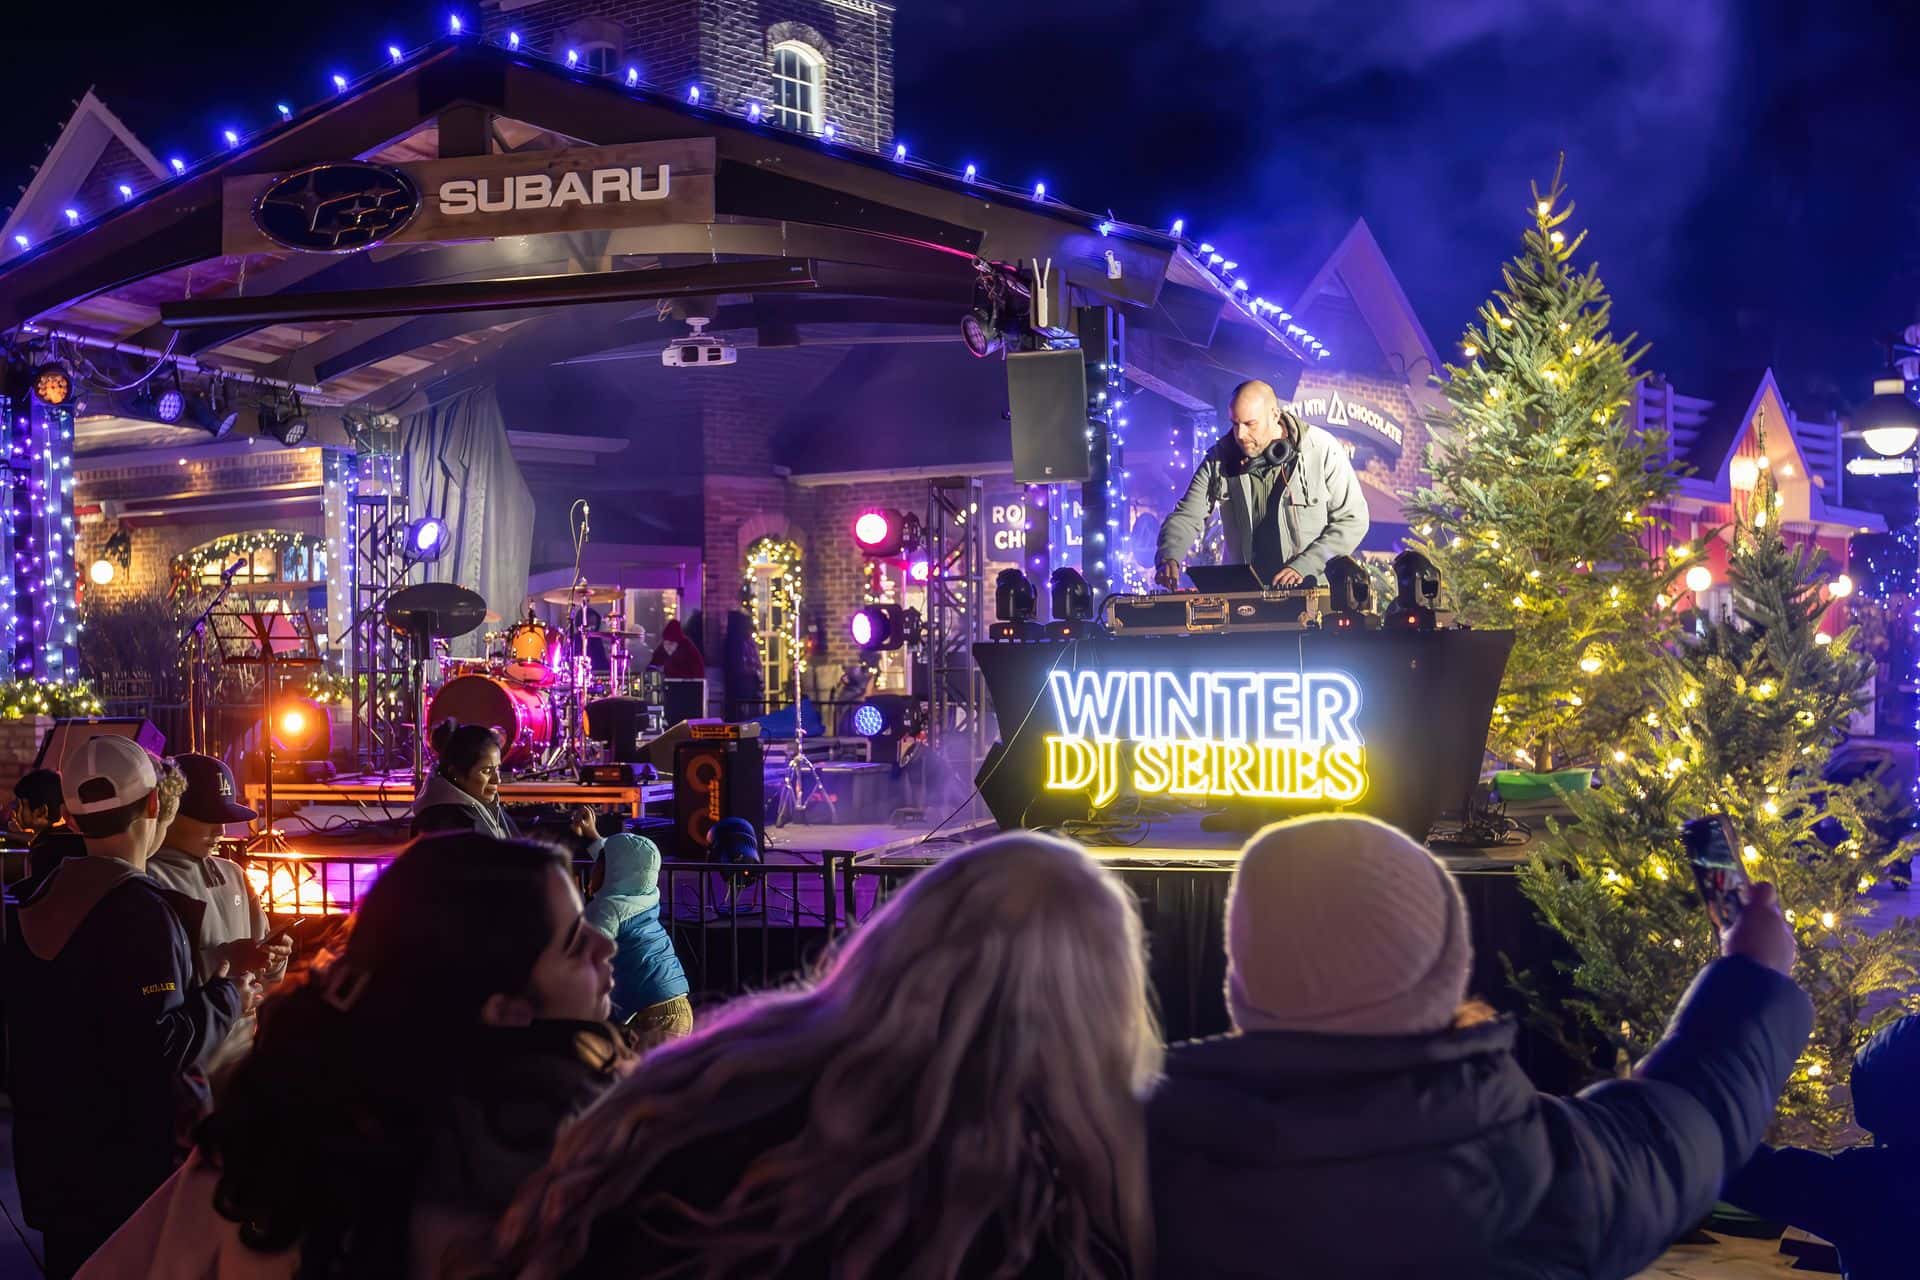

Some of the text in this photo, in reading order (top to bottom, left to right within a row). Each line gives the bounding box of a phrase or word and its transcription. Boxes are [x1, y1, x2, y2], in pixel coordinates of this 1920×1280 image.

[439, 164, 670, 215] SUBARU
[1347, 402, 1402, 445] CHOCOLATE
[1049, 670, 1362, 745] WINTER
[216, 772, 232, 796] LA
[1045, 736, 1368, 808] DJ SERIES
